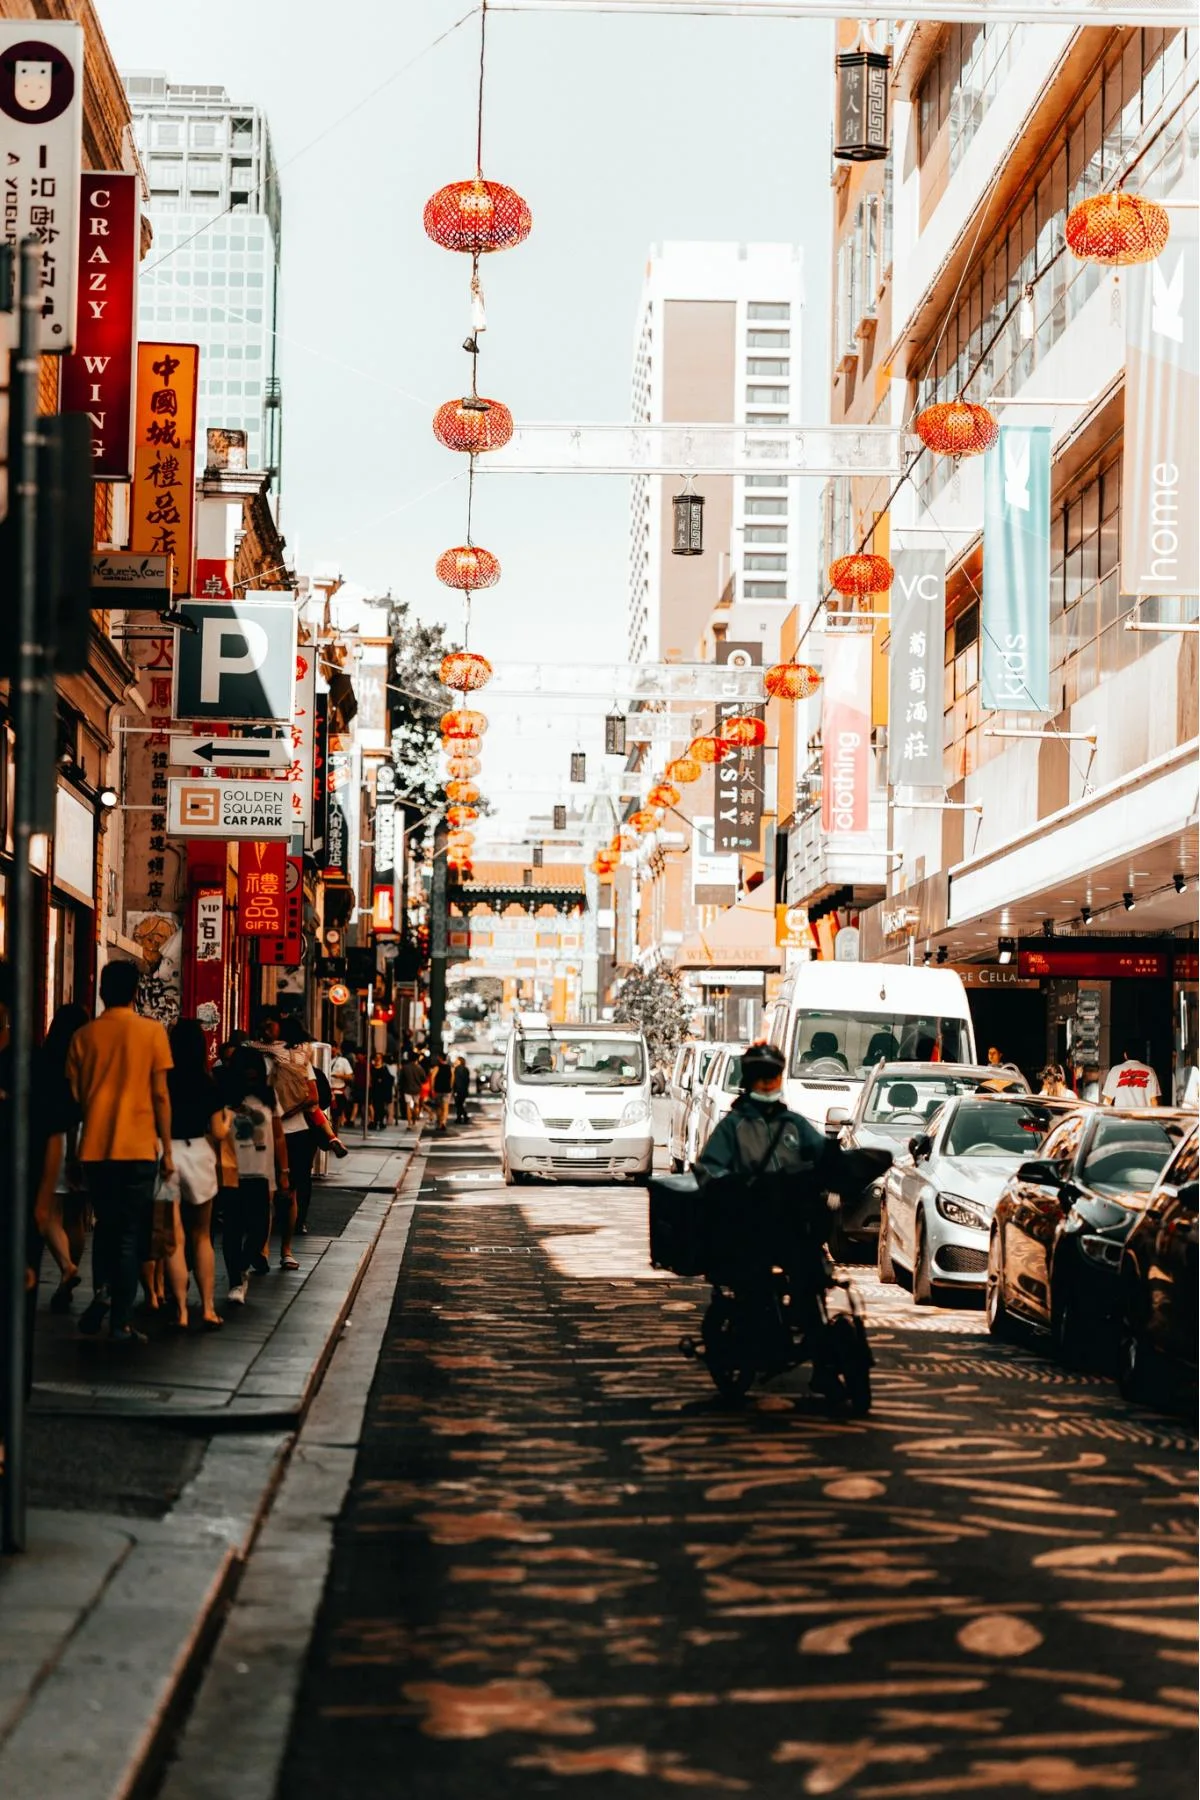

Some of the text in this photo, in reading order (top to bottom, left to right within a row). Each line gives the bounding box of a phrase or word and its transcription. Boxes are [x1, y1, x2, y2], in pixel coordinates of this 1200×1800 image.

[7, 151, 20, 166] A
[5, 176, 18, 250] YOGUR
[83, 190, 111, 458] CRAZY WING
[144, 354, 183, 556] 中國城禮品店
[1141, 461, 1179, 582] home
[202, 574, 226, 598] 卓
[899, 575, 938, 600] VC
[201, 617, 269, 703] P
[996, 634, 1027, 700] kids
[903, 631, 929, 760] 葡萄酒莊
[223, 790, 283, 802] GOLDEN
[831, 731, 860, 829] clothing
[223, 803, 282, 814] SQUARE
[223, 815, 282, 826] CAR PARK
[201, 904, 220, 912] VIP
[245, 873, 279, 918] 禮品
[245, 920, 279, 930] GIFTS
[978, 969, 1031, 984] CELLA
